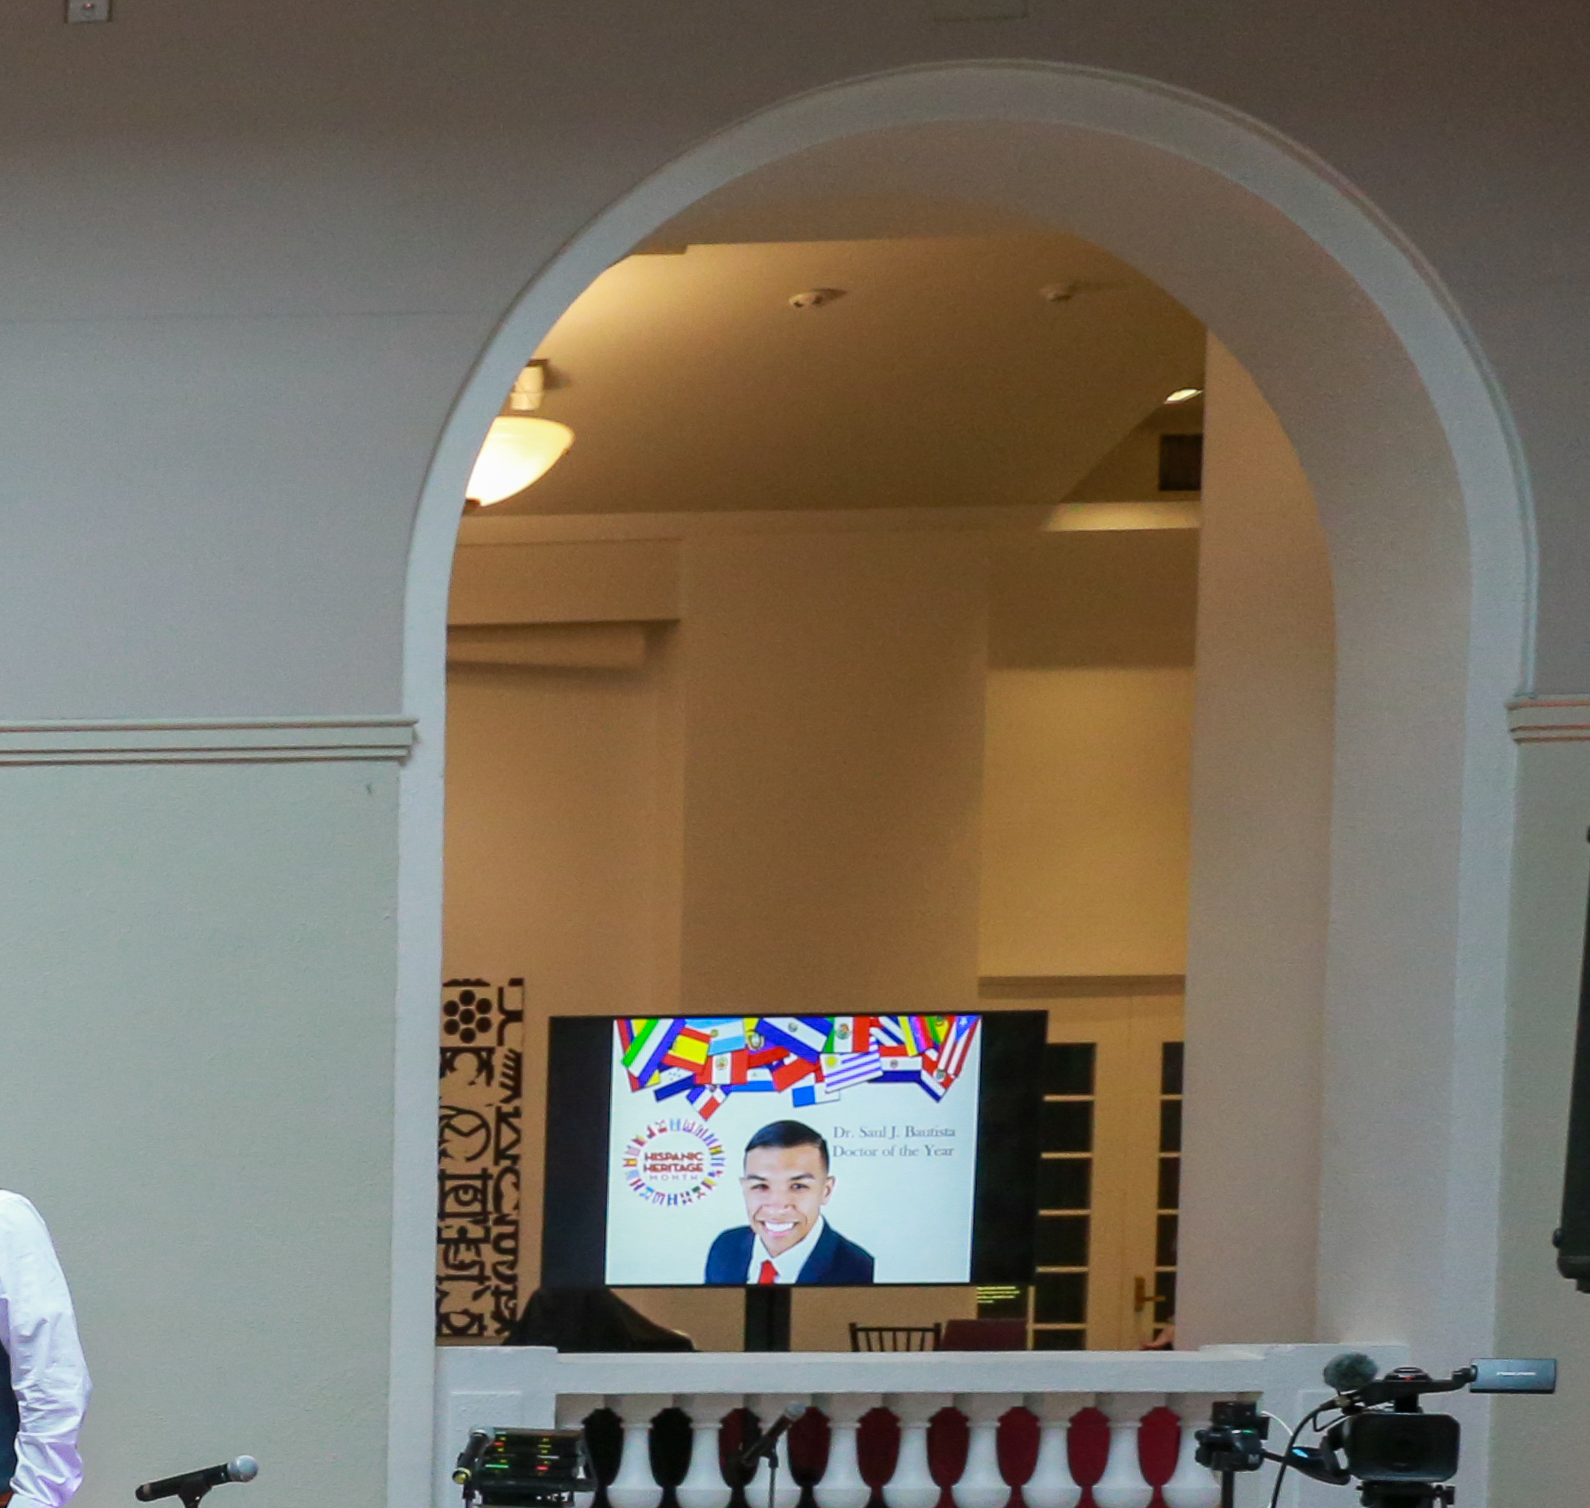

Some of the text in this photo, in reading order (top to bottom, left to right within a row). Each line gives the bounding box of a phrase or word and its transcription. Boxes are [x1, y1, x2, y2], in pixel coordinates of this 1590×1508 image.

[832, 1144, 955, 1157] Doctor of the Year
[644, 1152, 703, 1161] HISPANIC
[643, 1163, 703, 1172] HERITAGE
